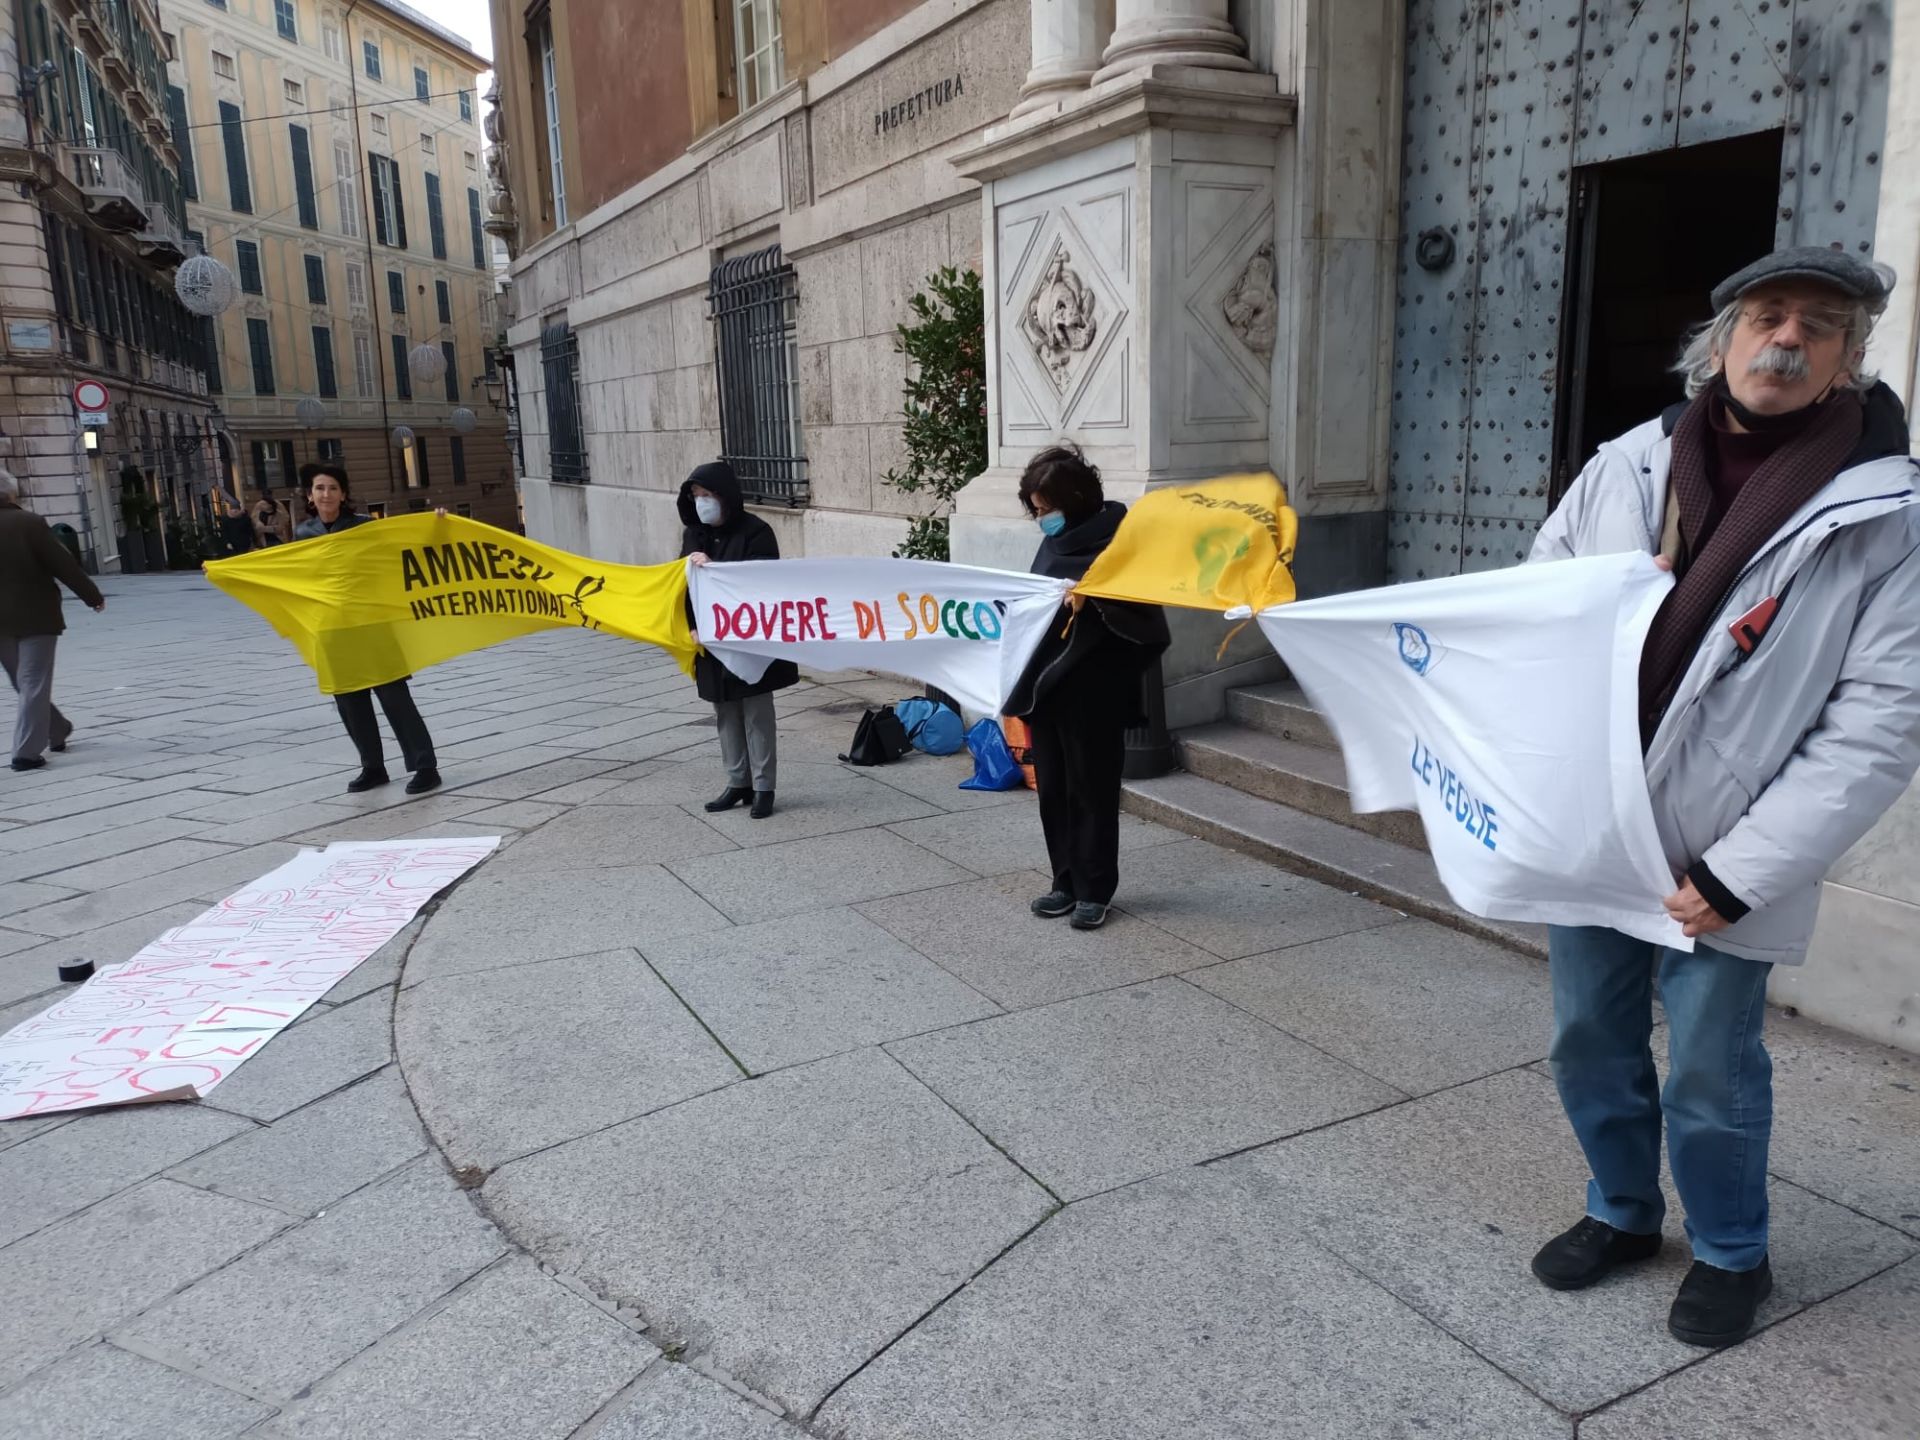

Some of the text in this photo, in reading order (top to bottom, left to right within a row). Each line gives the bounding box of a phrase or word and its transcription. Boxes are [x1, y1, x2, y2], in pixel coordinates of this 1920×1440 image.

[874, 72, 964, 136] PREFETTURA
[410, 588, 567, 620] INTERNATIONAL
[712, 591, 1010, 642] DOVERE DI SOCCO
[1411, 734, 1498, 851] LE VEGLIE
[95, 960, 273, 1044] MARE
[2, 1047, 151, 1116] ORA
[128, 1005, 290, 1093] 430
